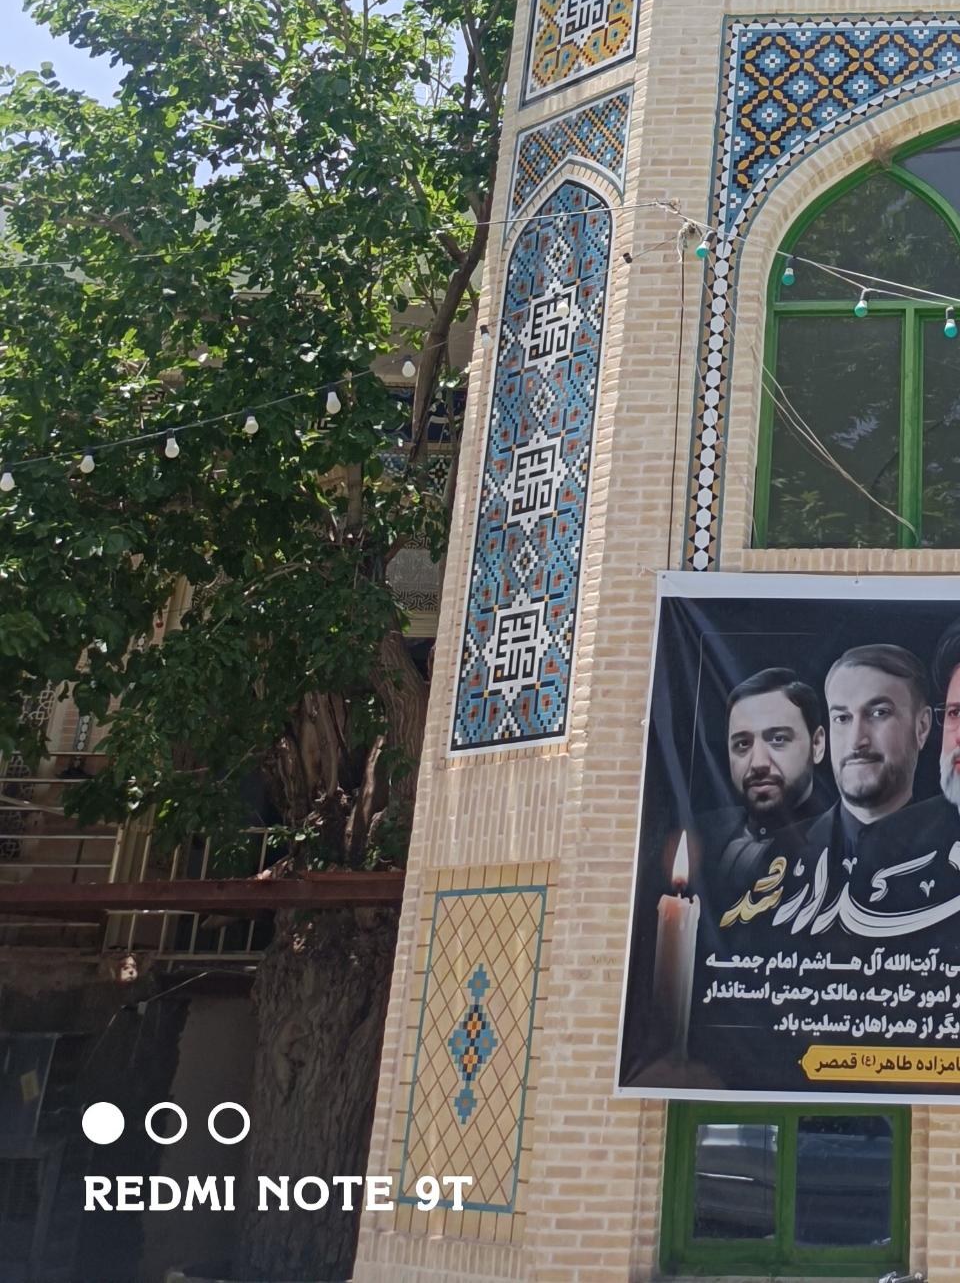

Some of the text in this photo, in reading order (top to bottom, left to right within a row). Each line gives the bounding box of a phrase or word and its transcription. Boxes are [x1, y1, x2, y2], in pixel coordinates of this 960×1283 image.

[719, 855, 788, 929] شد
[705, 953, 764, 974] جمعه
[765, 951, 798, 976] امام
[798, 951, 862, 976] هاشم
[863, 947, 886, 976] آل
[702, 981, 770, 1003] استاندار
[771, 983, 819, 1005] رحمتی
[821, 983, 858, 1002] مالک
[917, 985, 951, 1008] امور
[801, 1014, 851, 1036] تسلیت
[852, 1015, 918, 1038] همراهان
[919, 1014, 934, 1039] از
[814, 1053, 858, 1073] قمصر
